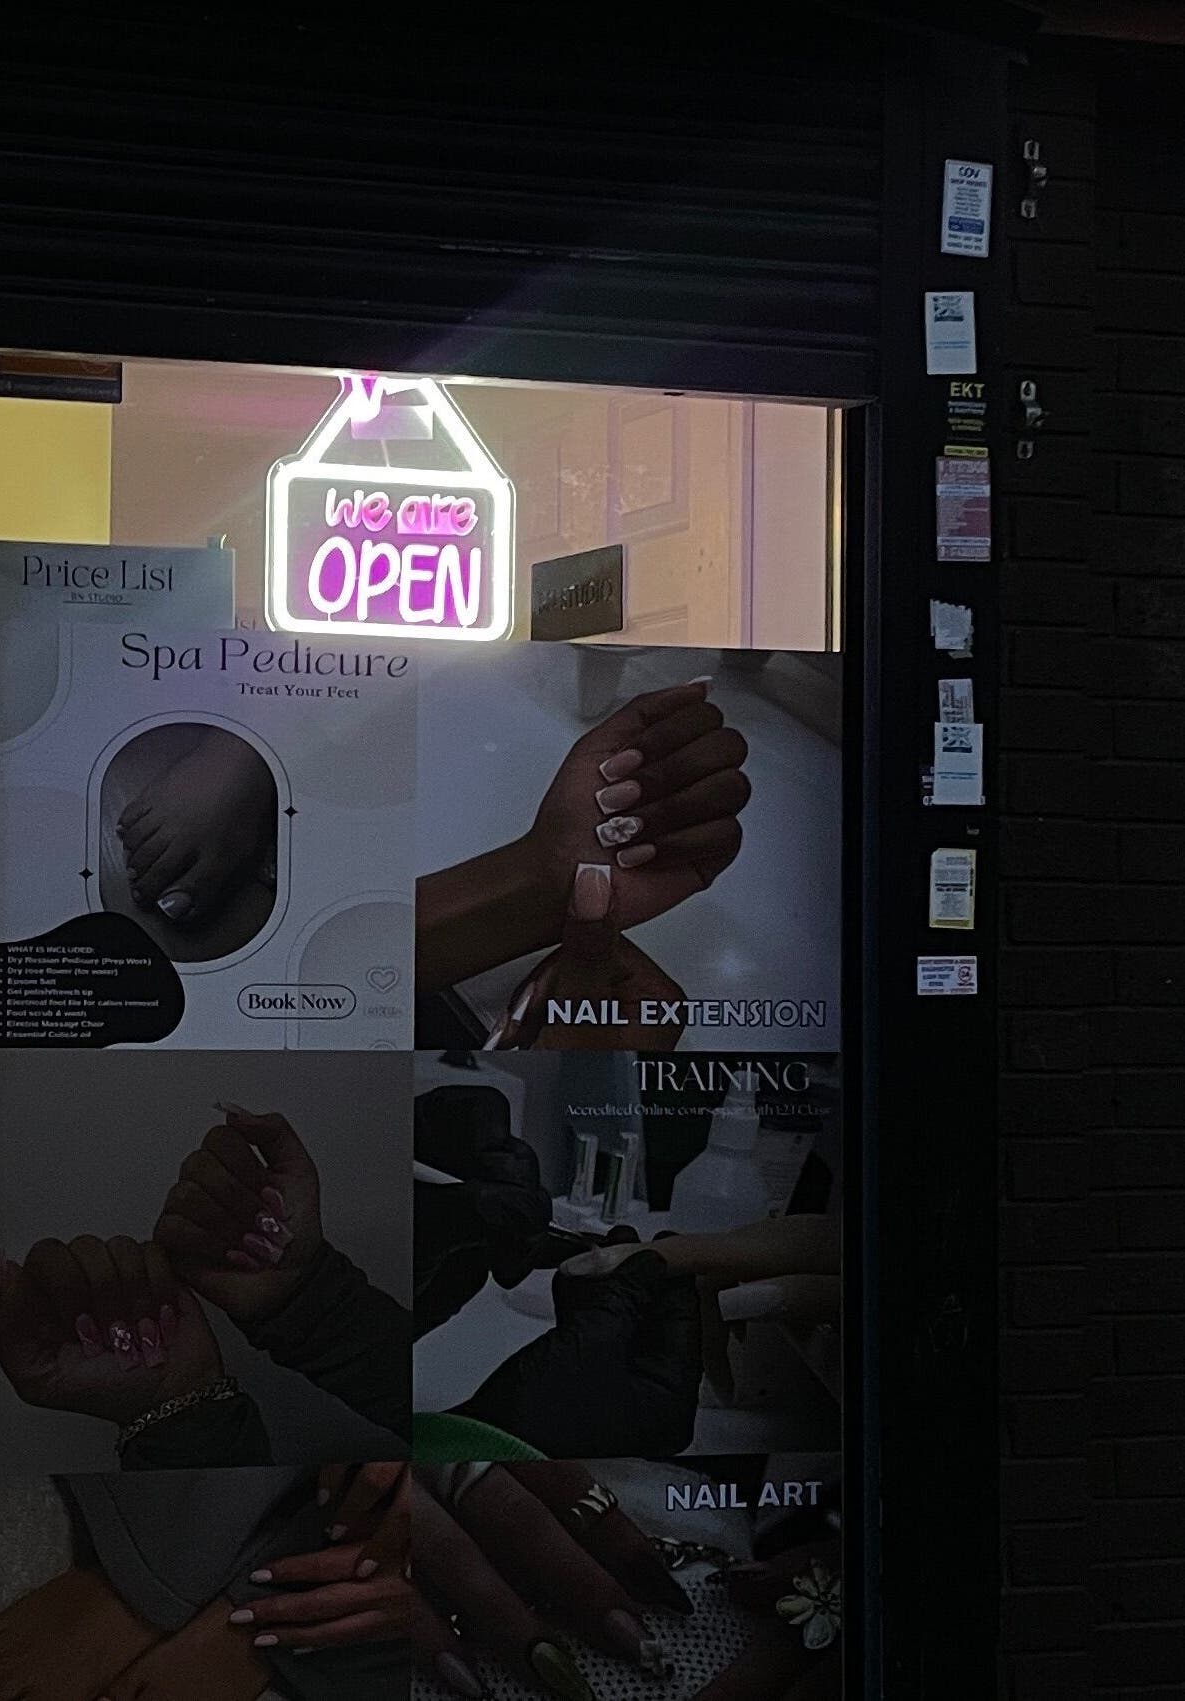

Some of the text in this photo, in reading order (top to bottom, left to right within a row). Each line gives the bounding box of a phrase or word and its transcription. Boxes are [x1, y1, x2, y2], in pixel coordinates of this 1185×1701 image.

[950, 382, 985, 398] EKT
[397, 491, 479, 536] are
[22, 555, 174, 592] Price List
[308, 535, 482, 627] OPEN
[121, 633, 409, 681] Spa Pedicure
[236, 682, 360, 699] Treat Your Feet
[7, 945, 34, 954] WHAT
[7, 957, 23, 966] Dry
[7, 968, 23, 976] Dry
[247, 992, 346, 1010] Book Now
[547, 998, 827, 1028] NAIL EXTENSION
[632, 1060, 812, 1093] TRAINING
[567, 1103, 633, 1116] Accredited
[634, 1103, 675, 1116] Online
[666, 1481, 824, 1510] NAIL ART
